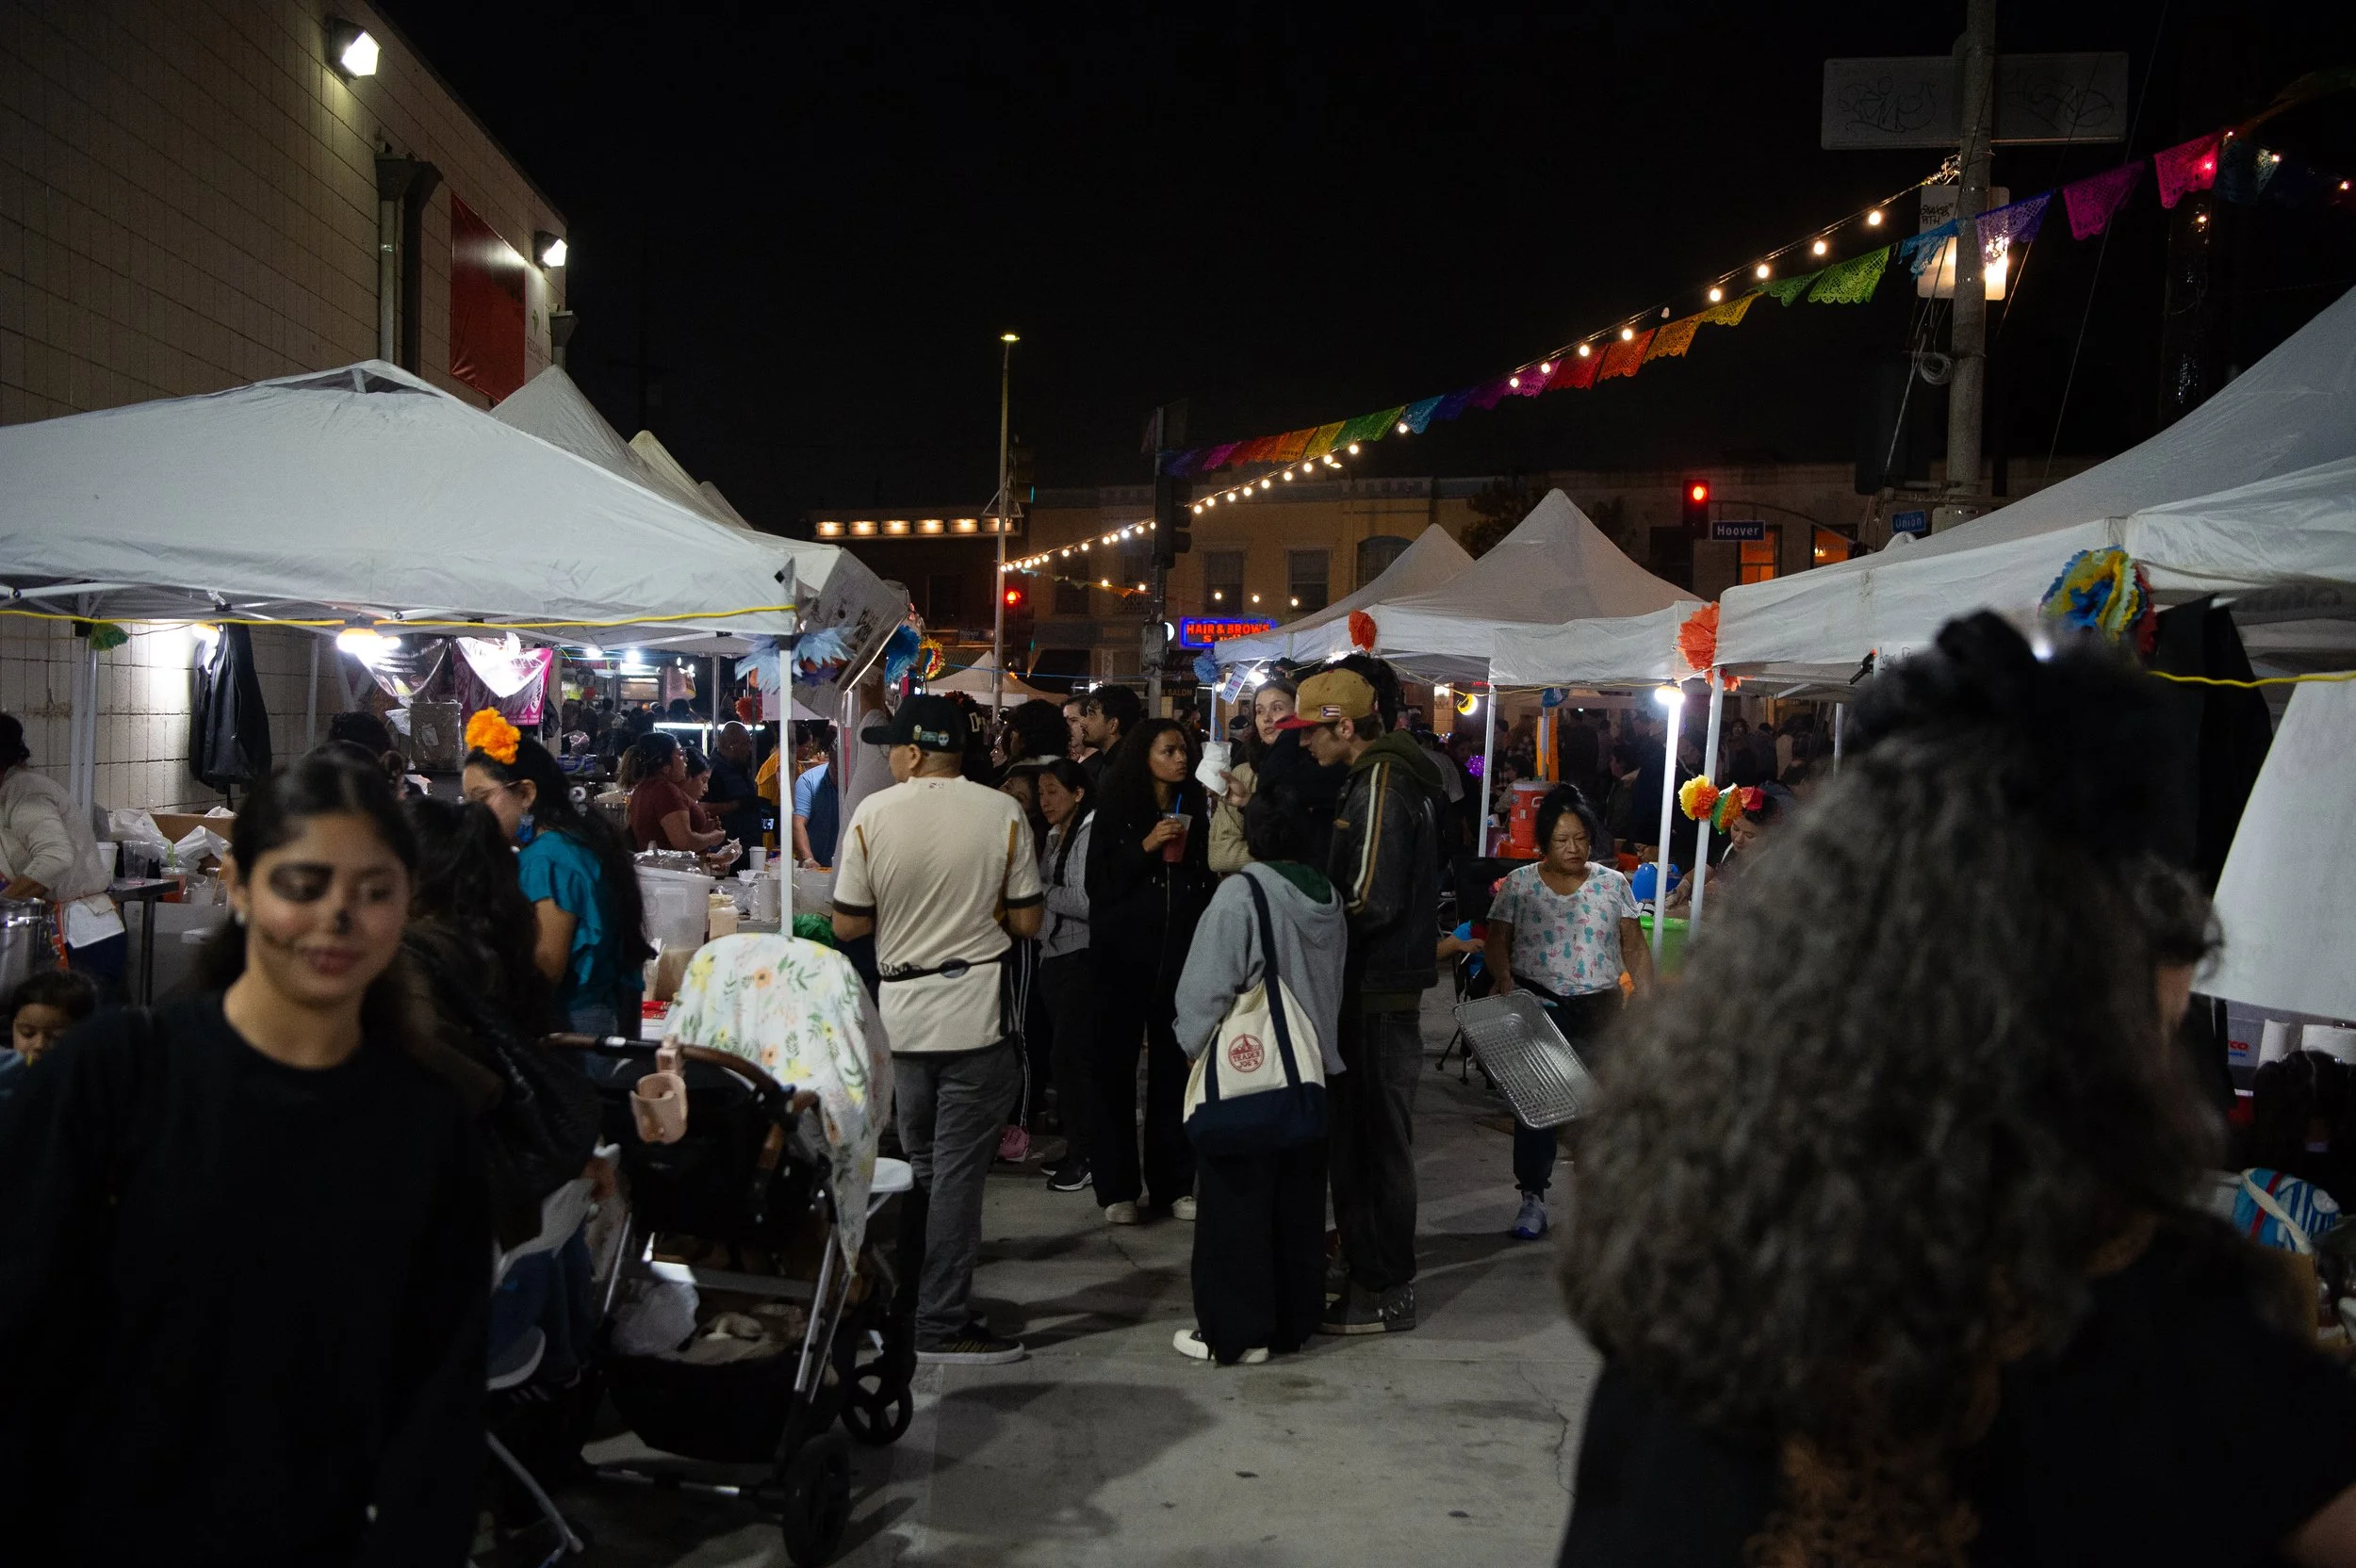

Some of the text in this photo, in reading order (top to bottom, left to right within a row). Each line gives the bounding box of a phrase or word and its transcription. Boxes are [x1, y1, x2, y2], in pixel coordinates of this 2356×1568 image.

[1895, 516, 1922, 529] Union
[1717, 525, 1760, 537] Hoover
[1186, 623, 1269, 634] HAIR & BROWS
[1168, 688, 1192, 696] SALON
[1233, 1050, 1261, 1062] TRADER
